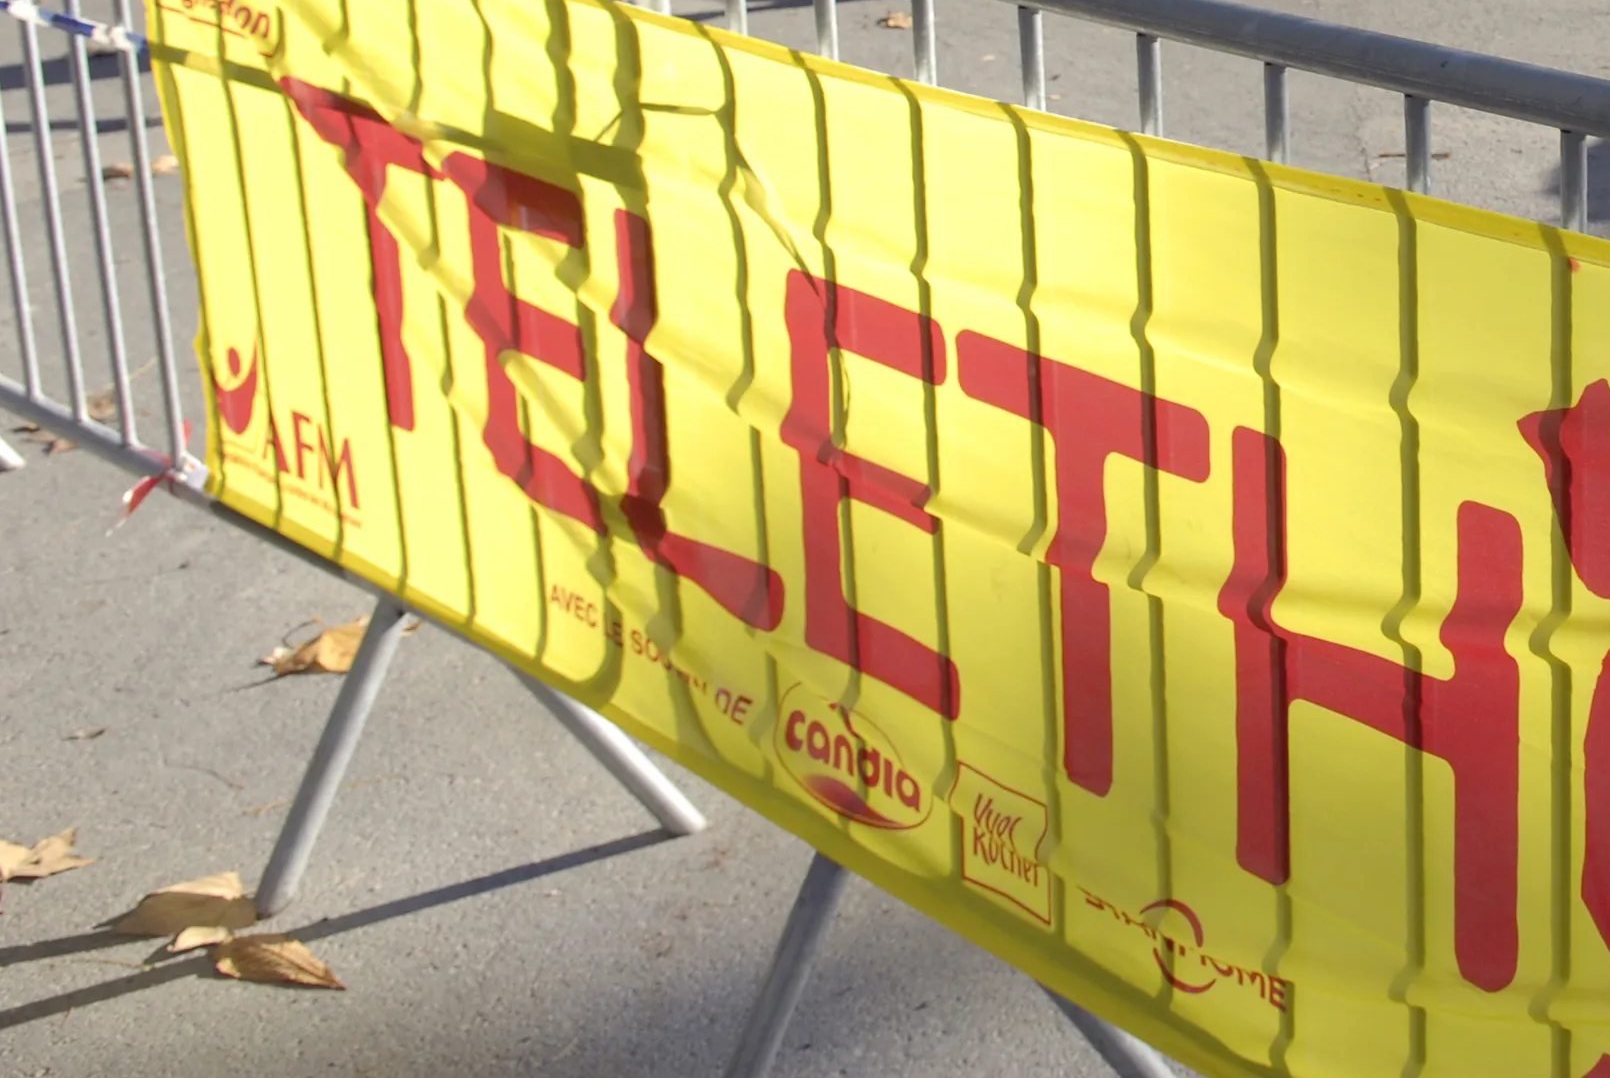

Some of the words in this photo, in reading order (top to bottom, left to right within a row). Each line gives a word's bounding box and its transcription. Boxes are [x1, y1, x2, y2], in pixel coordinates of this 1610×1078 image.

[262, 408, 361, 510] AFM
[550, 584, 599, 629] AVEC
[784, 702, 921, 814] candia
